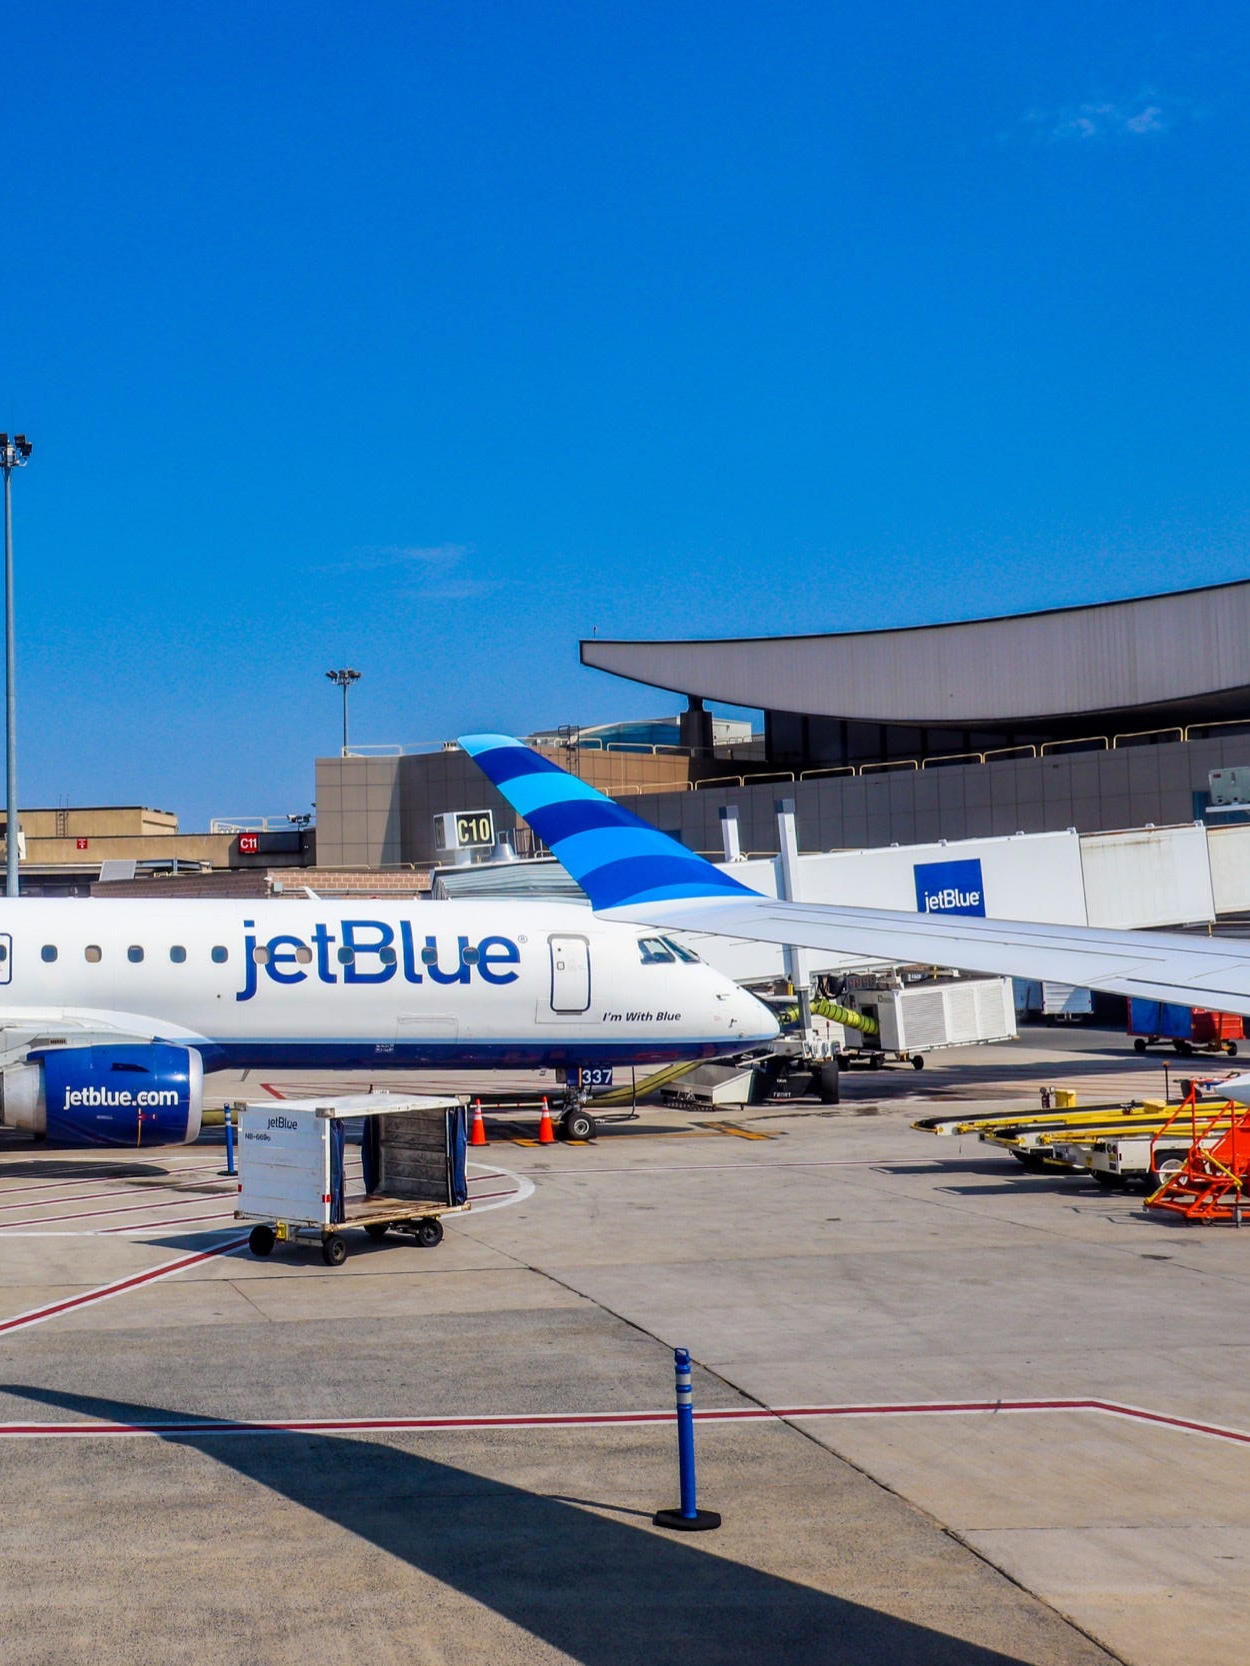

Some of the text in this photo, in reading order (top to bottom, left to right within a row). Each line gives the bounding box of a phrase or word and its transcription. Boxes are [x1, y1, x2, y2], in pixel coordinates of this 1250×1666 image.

[458, 818, 490, 843] C10
[240, 838, 257, 849] C11
[924, 888, 979, 913] jetBlue
[602, 1011, 682, 1022] I'm With Blue
[582, 1069, 612, 1084] 337
[63, 1086, 179, 1110] jetblue.com
[266, 1116, 298, 1130] jetBlue
